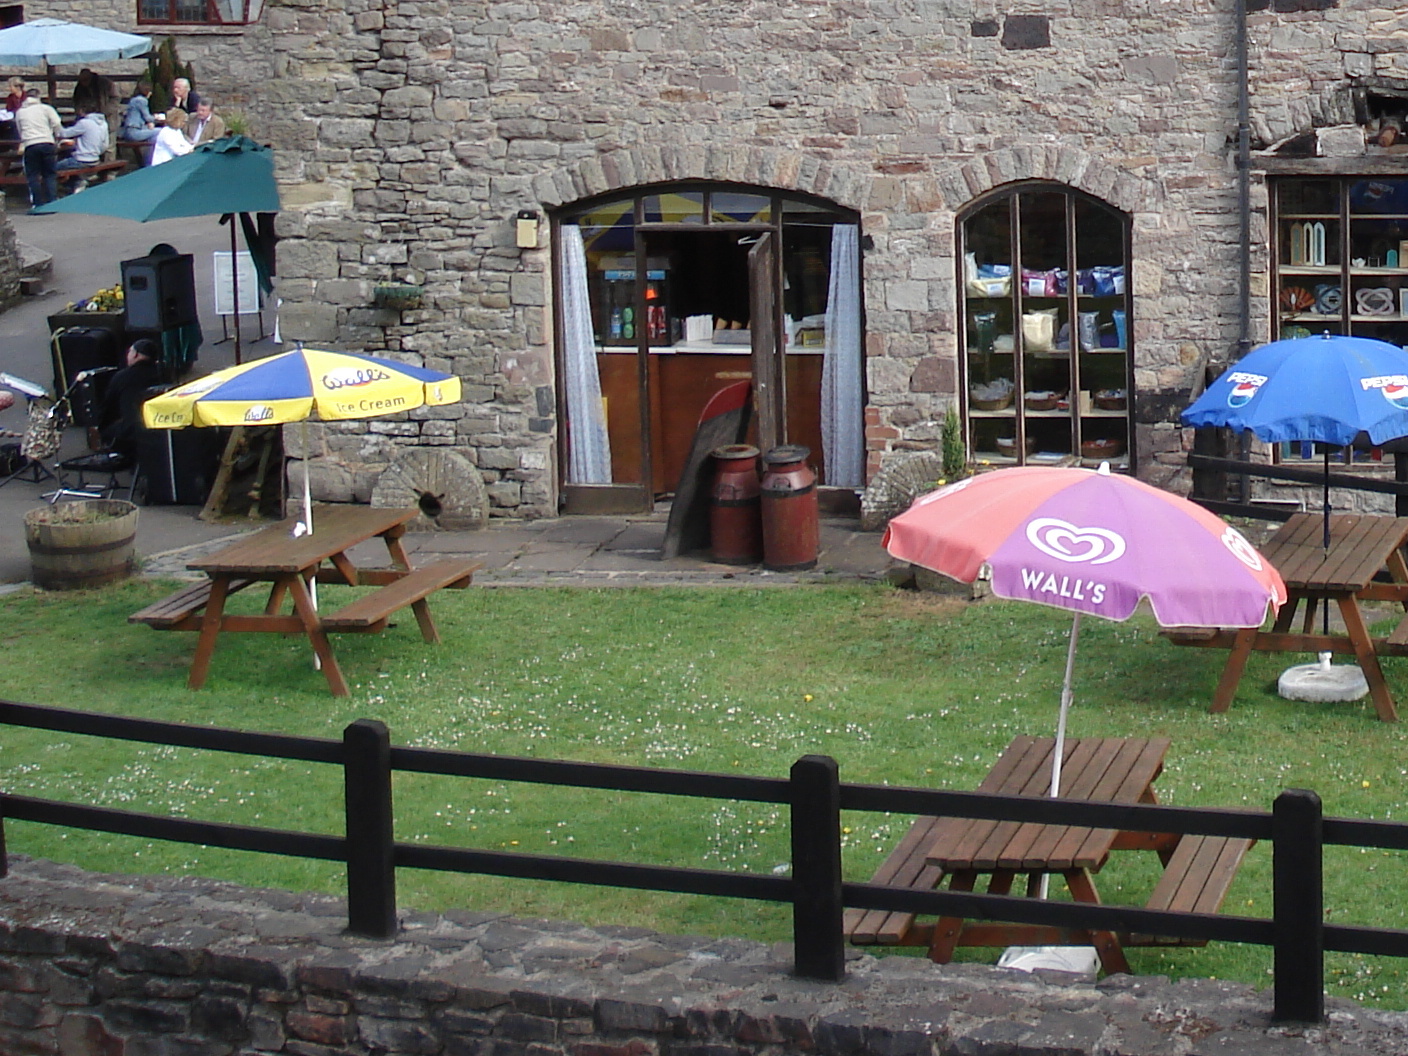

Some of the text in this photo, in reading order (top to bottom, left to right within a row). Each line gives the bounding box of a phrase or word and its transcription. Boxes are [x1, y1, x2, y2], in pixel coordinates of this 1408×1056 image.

[1226, 372, 1268, 387] PEPSI
[337, 396, 405, 412] Ice Cream
[1021, 568, 1106, 604] WALL'S
